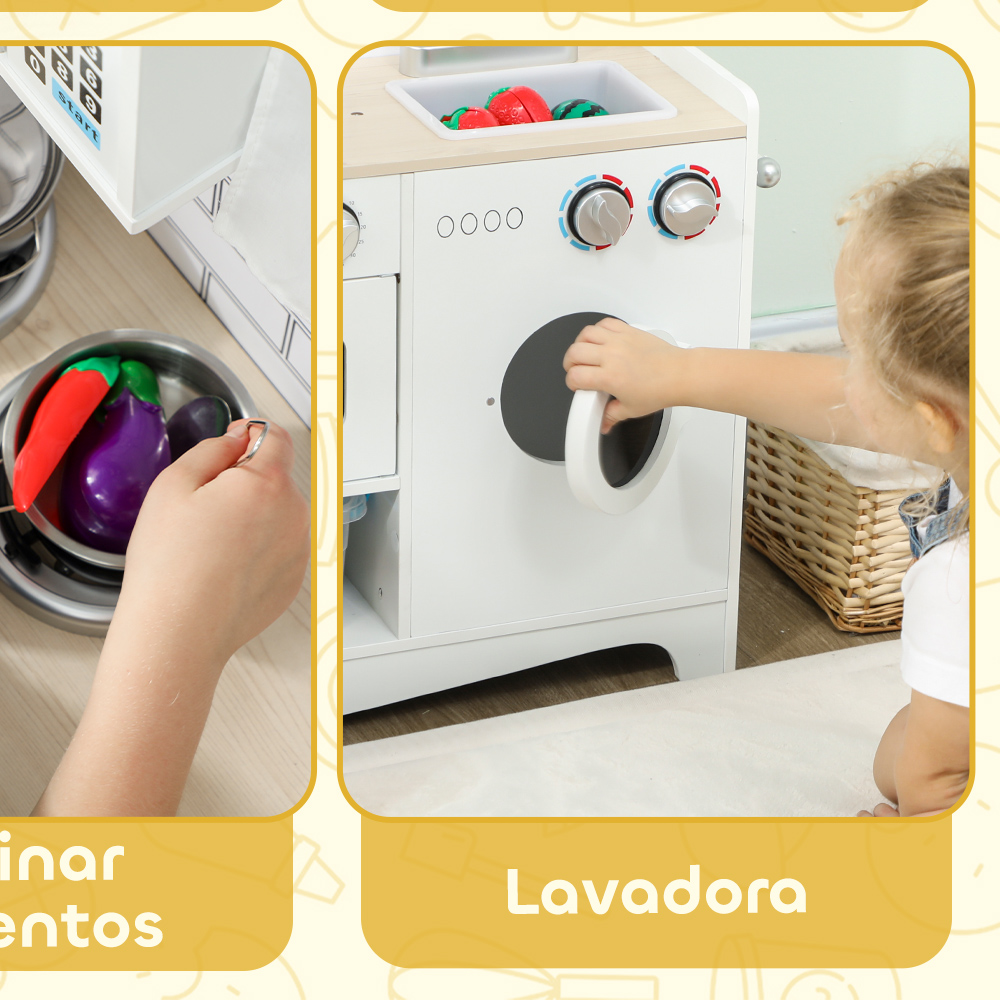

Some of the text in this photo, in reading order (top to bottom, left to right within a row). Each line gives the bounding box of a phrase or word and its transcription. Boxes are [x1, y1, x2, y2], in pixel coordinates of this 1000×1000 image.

[29, 54, 99, 143] 0 start
[56, 60, 69, 82] 8
[85, 93, 98, 115] 9
[85, 67, 98, 89] 6
